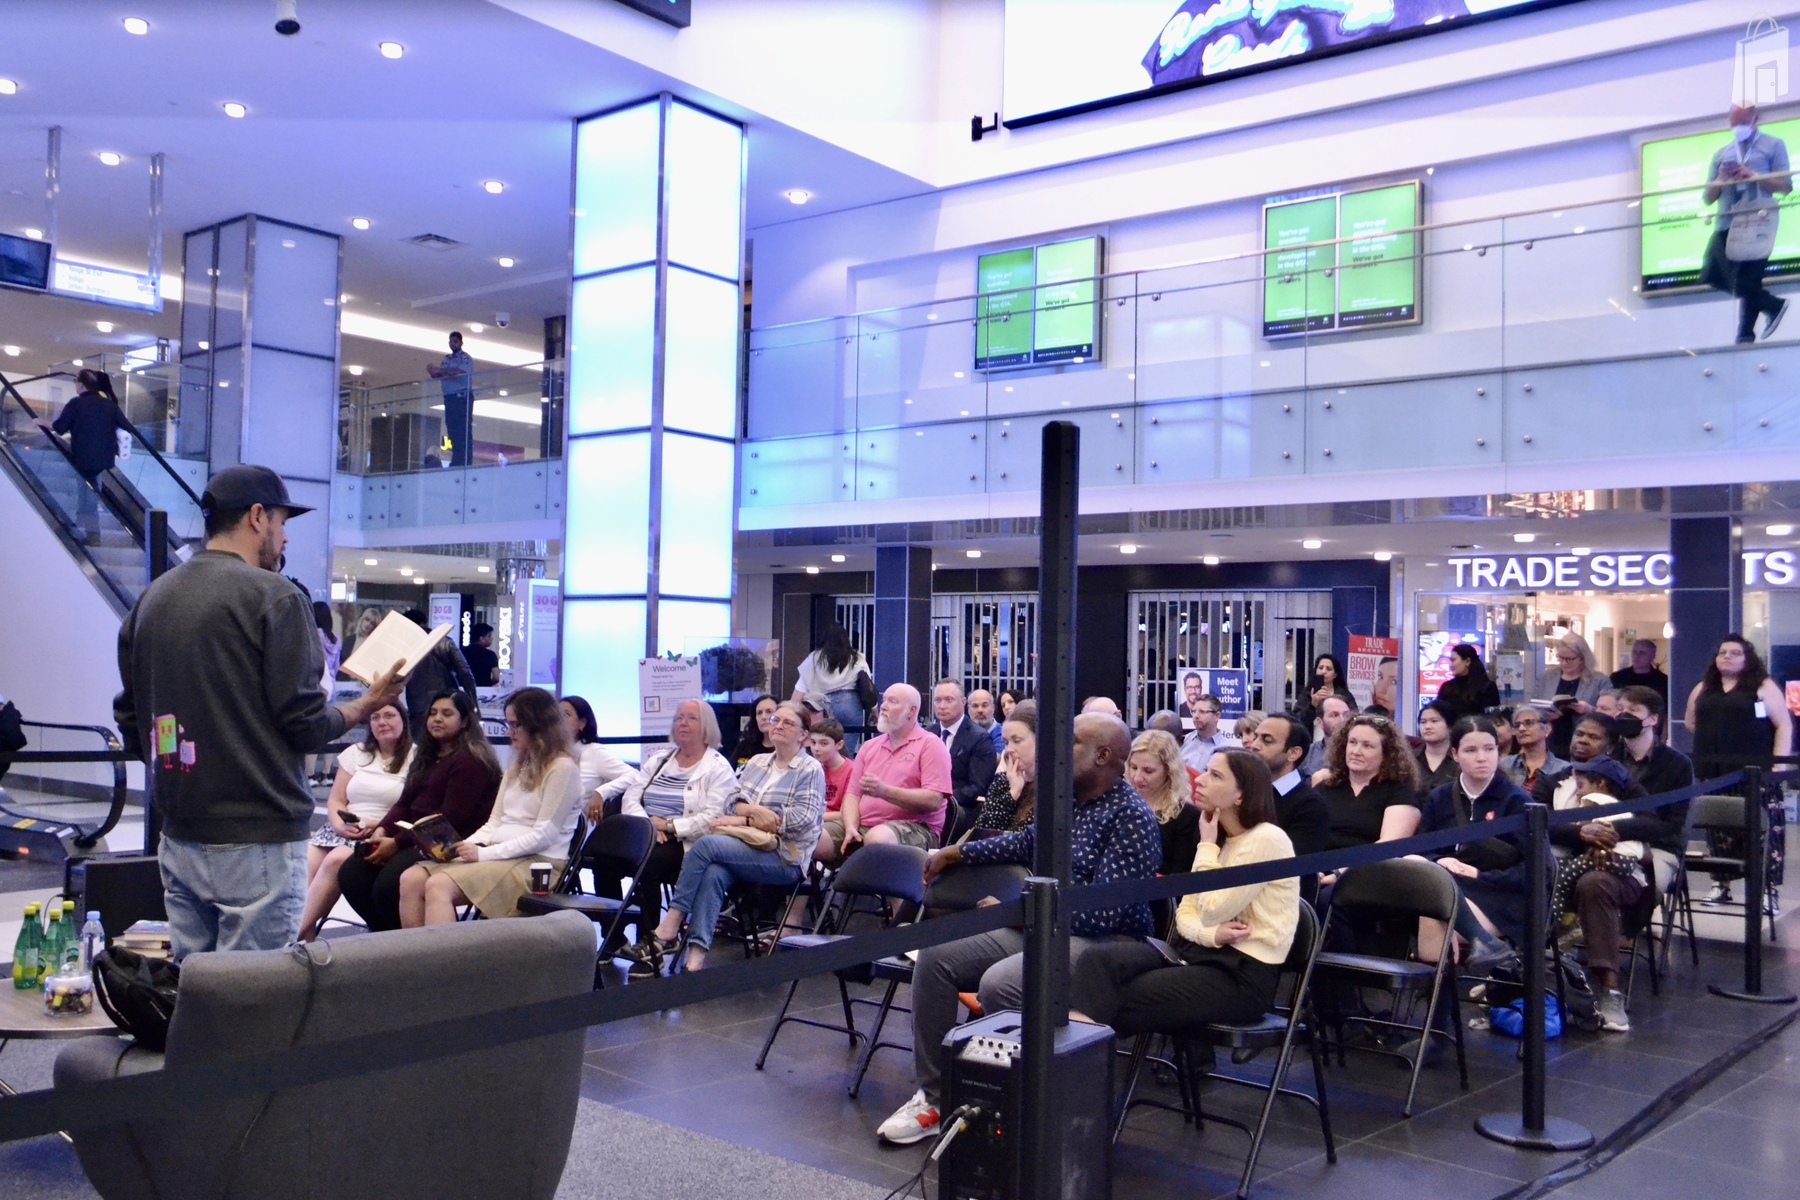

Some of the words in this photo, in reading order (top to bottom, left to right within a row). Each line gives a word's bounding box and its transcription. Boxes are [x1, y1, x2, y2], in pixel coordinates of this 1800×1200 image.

[1448, 556, 1580, 588] TRADE
[1590, 551, 1794, 587] SECTS
[535, 596, 549, 605] 30
[550, 596, 558, 605] G
[433, 605, 442, 615] 30
[443, 605, 453, 614] GB
[1365, 637, 1384, 648] TRADE
[1350, 655, 1377, 671] BROW
[652, 665, 687, 673] Welcome
[1349, 670, 1376, 680] SERVICES
[1217, 677, 1239, 686] Meet
[1221, 686, 1235, 695] the
[1217, 695, 1242, 704] uthor
